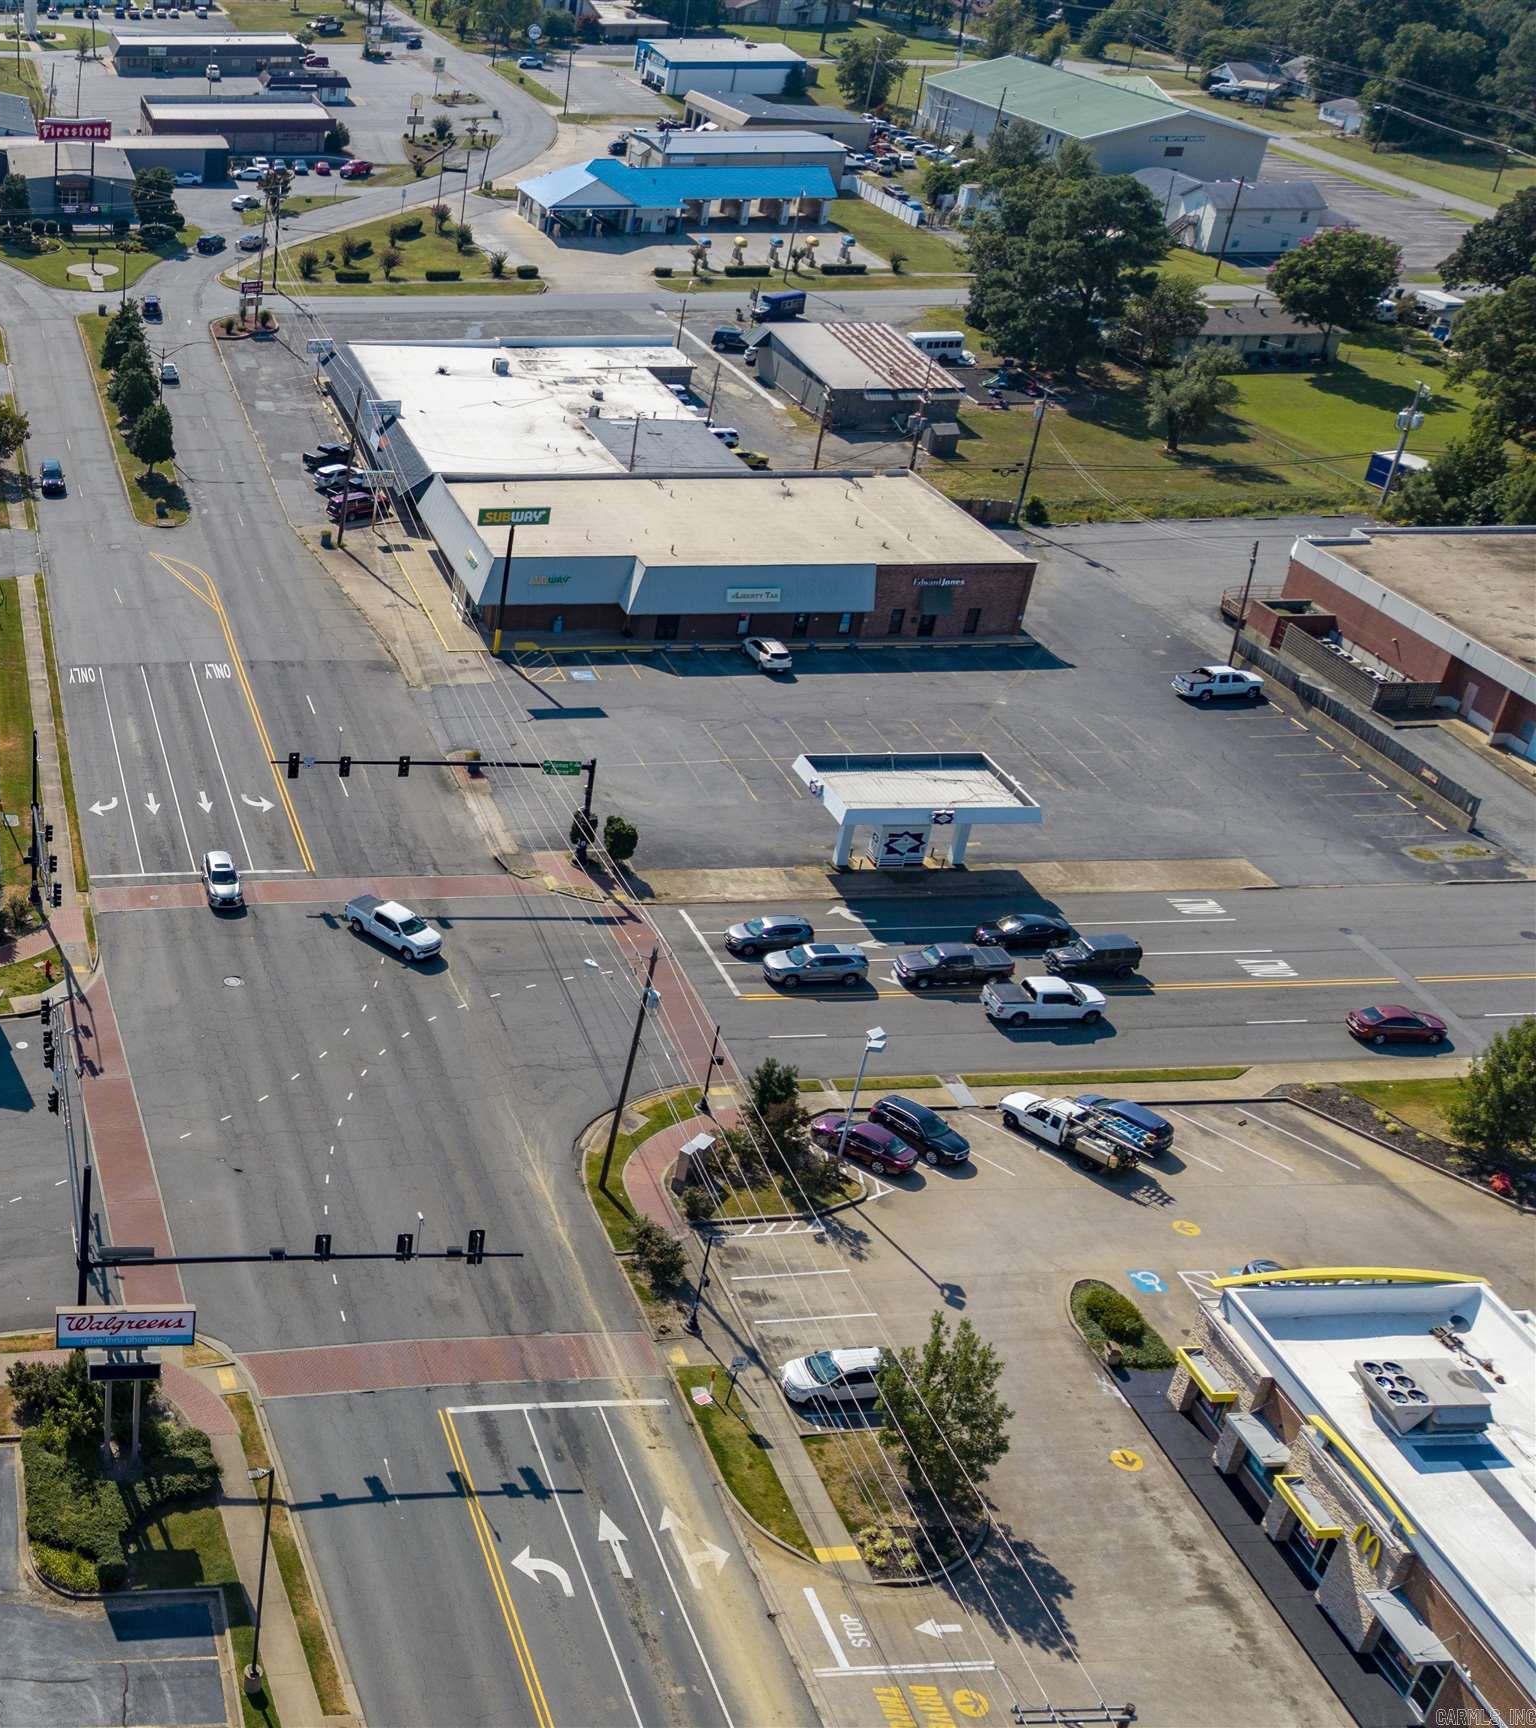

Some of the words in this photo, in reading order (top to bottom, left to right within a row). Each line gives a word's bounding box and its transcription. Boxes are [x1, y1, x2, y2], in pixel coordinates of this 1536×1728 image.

[41, 124, 110, 138] Firestone
[483, 510, 547, 523] SUBWAY
[528, 576, 572, 585] SUBWAY
[69, 667, 96, 684] ONLY
[204, 663, 231, 680] ONLY
[1166, 898, 1226, 915] ONLY
[1234, 959, 1299, 977] ONLY
[66, 1315, 186, 1335] Walgreens
[840, 1614, 871, 1648] STOP
